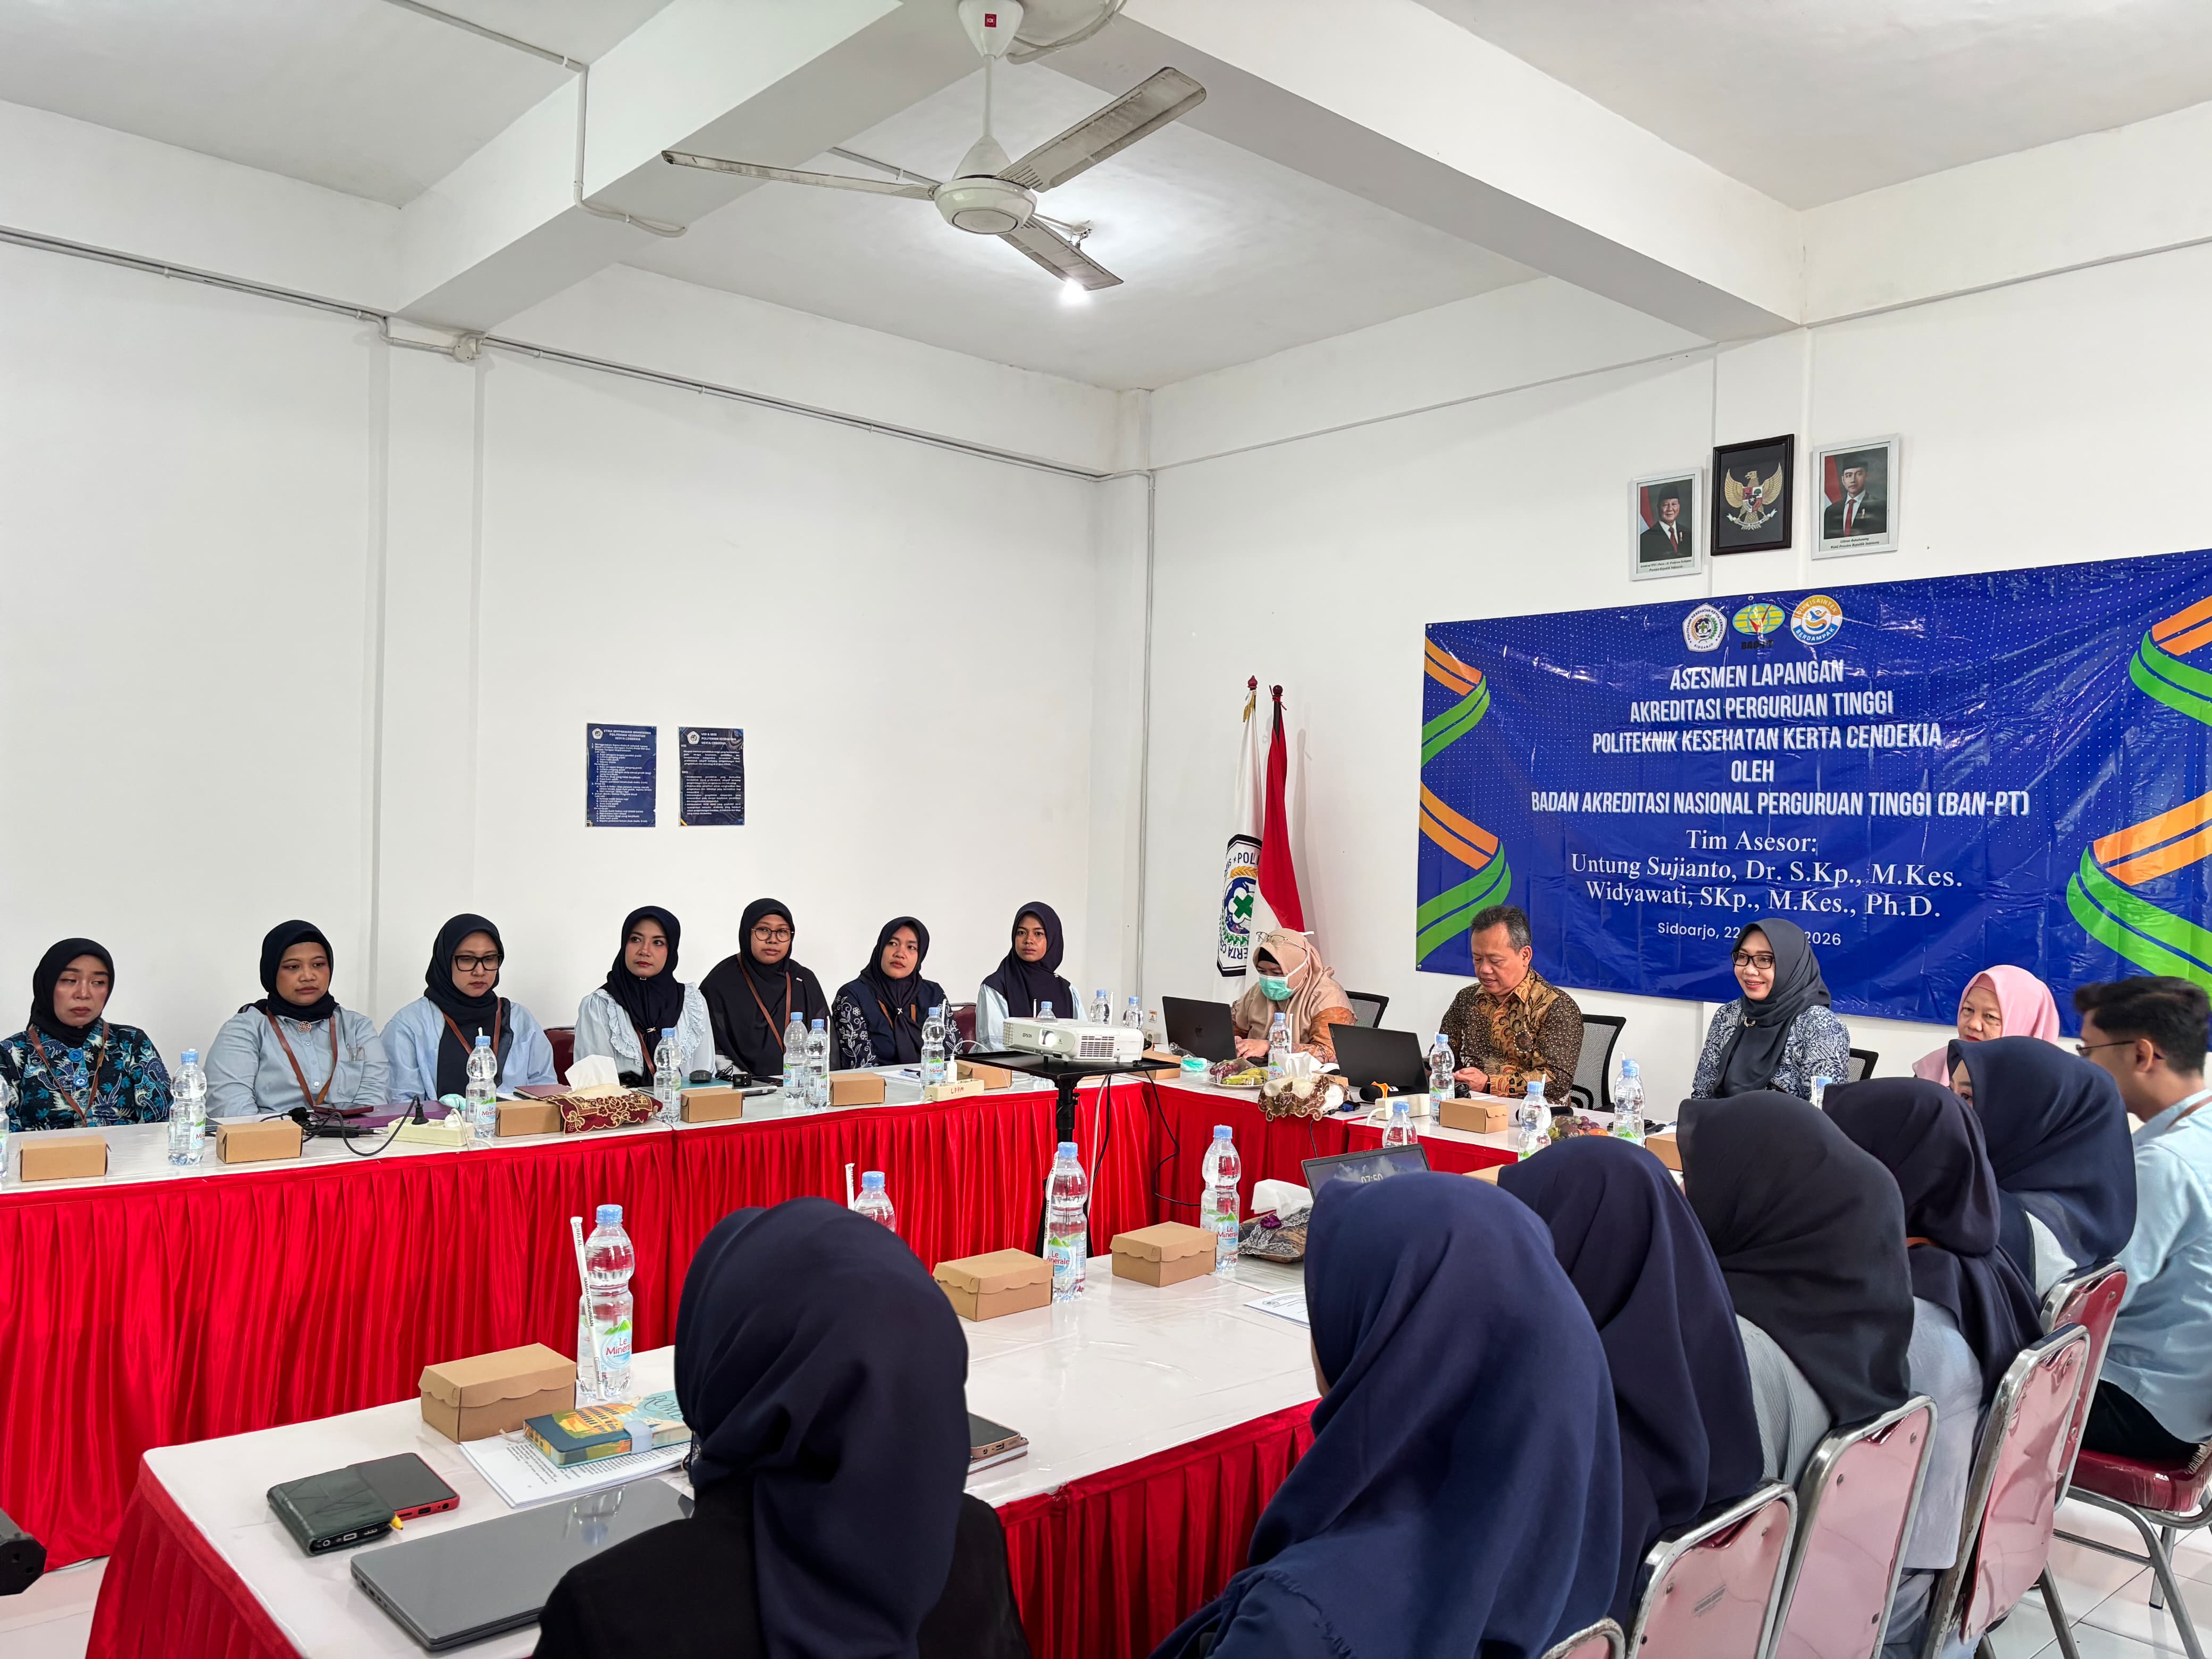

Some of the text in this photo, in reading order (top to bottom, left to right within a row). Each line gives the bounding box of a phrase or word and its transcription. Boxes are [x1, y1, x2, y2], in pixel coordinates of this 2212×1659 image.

[1795, 627, 1835, 641] BERDAMPAK
[1670, 659, 1844, 691] ASESMEN LAPANGAN
[1630, 690, 1894, 723] AKREDITASI PERGURUAN TINGGI
[1593, 722, 1941, 753] POLITEKNIK KESEHATAN KERTA CENDEKIA
[1731, 759, 1775, 783] OLEH
[1531, 791, 2030, 817] BADAN AKREDITASI NASIONAL PERGURUAN TINGGI (BAN-PT)
[1686, 830, 1817, 852] Tim Asesor:
[1571, 853, 1963, 888] Untung Sujianto, Dr. S.Kp., M.Kes.
[1586, 881, 1940, 917] Widyawati, SKp., M.Kes., Ph.D.
[1657, 922, 1841, 945] Sidoarjo, 22 2026
[619, 1337, 627, 1346] Le
[644, 1395, 683, 1419] ROME
